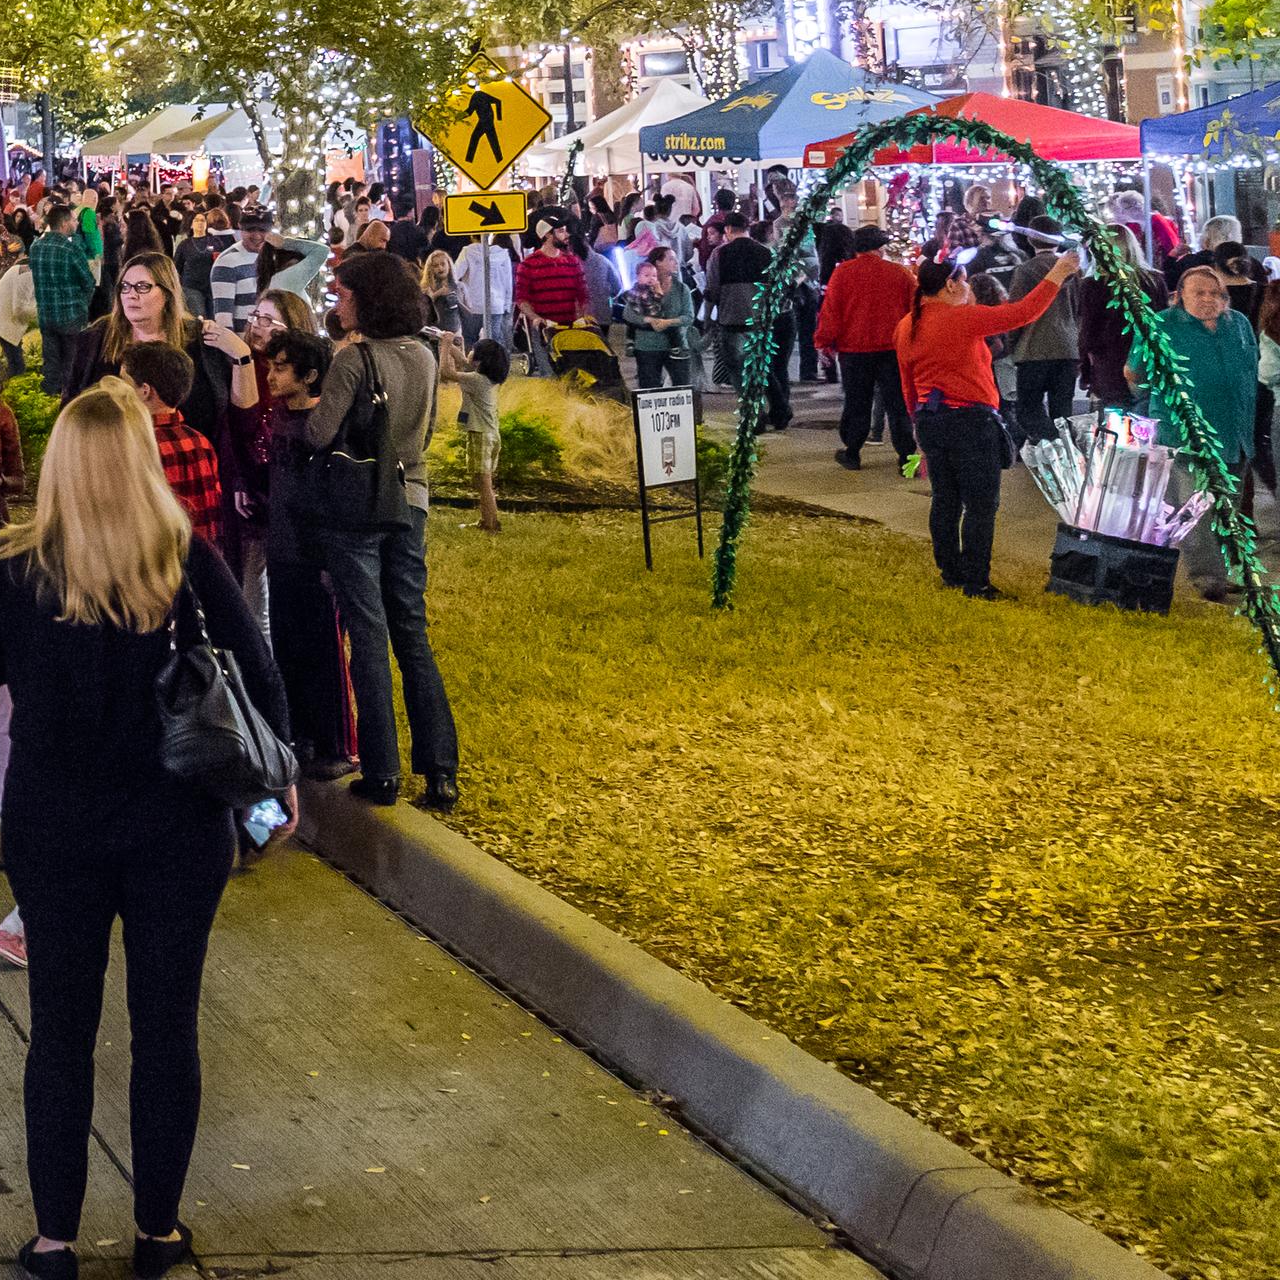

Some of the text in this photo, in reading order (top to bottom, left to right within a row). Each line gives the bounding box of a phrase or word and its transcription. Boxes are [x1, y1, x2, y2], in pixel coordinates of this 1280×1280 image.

[665, 132, 726, 150] strikz.com
[638, 393, 692, 410] Tune your radio to
